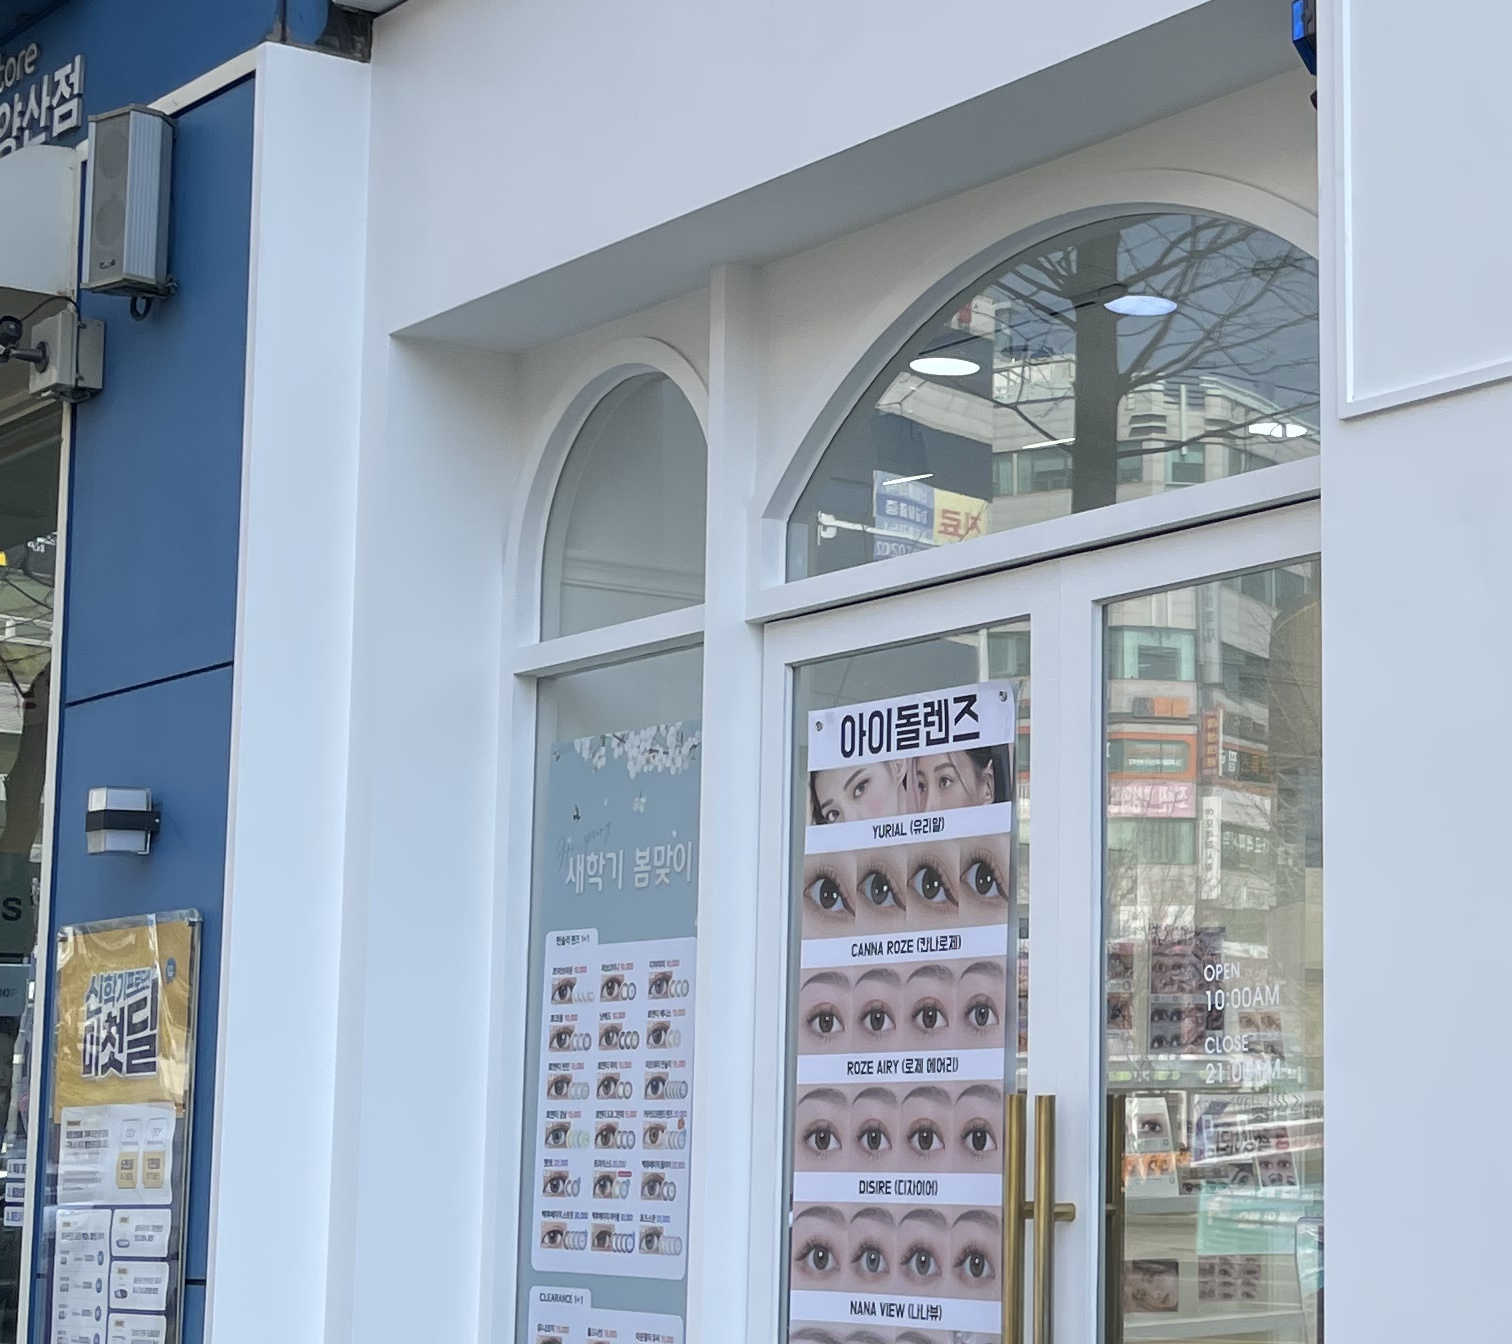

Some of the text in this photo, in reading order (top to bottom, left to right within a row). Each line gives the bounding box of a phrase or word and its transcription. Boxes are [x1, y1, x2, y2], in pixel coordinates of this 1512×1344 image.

[839, 693, 980, 759] 아이돌렌즈
[872, 822, 907, 840] YURIAL
[565, 849, 624, 894] 새학기
[633, 841, 693, 888] 봄맞이
[851, 941, 883, 957] CANNA
[887, 939, 914, 955] ROZE
[1204, 961, 1241, 983] OPEN
[1205, 985, 1280, 1012] 10:00AM
[1205, 1033, 1250, 1055] CLOSE
[847, 1060, 874, 1076] ROZE
[876, 1059, 899, 1075] AIRY
[859, 1179, 892, 1195] DISIRE
[850, 1300, 877, 1316] NANA
[880, 1302, 905, 1319] VIEW
